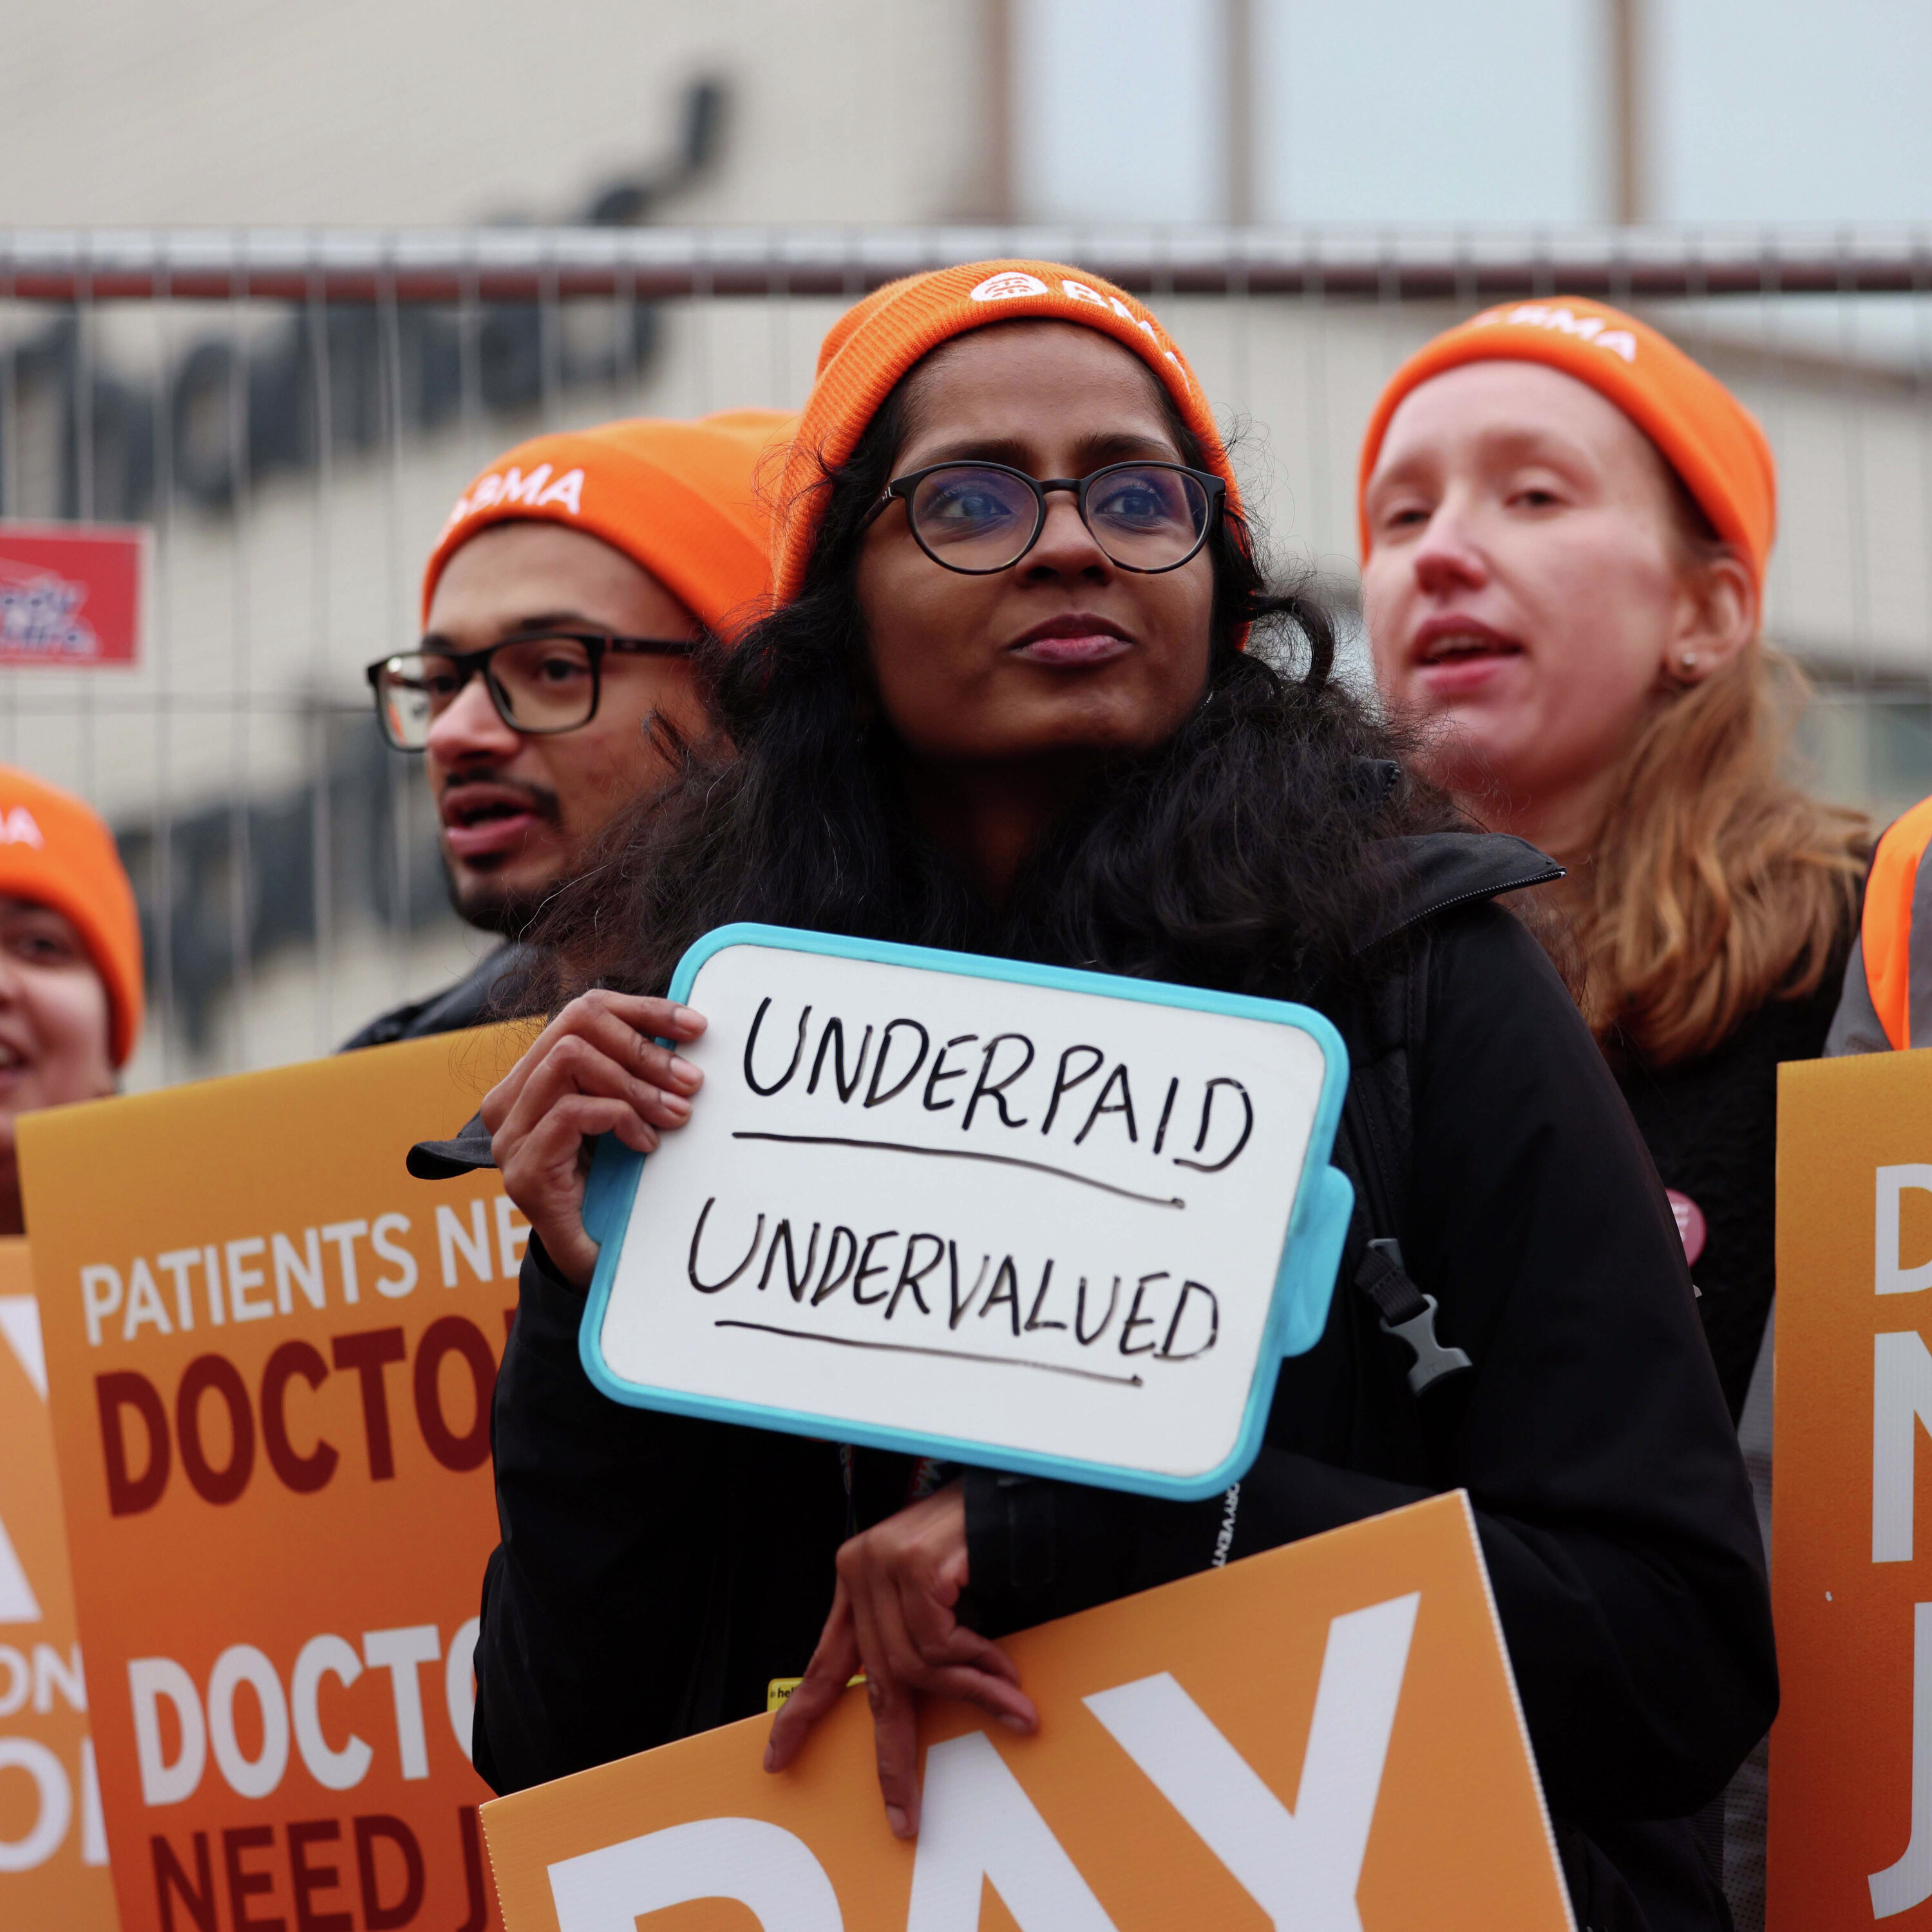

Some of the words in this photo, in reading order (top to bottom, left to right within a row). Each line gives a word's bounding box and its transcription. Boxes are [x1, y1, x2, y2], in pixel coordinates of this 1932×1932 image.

[0, 805, 46, 851] A
[743, 996, 1254, 1172] UNDERPAID
[80, 1213, 419, 1346] PATIENTS
[688, 1197, 1219, 1360] UNDERVALUED
[94, 1308, 518, 1519] DOCTO
[149, 1814, 426, 1932] NEED
